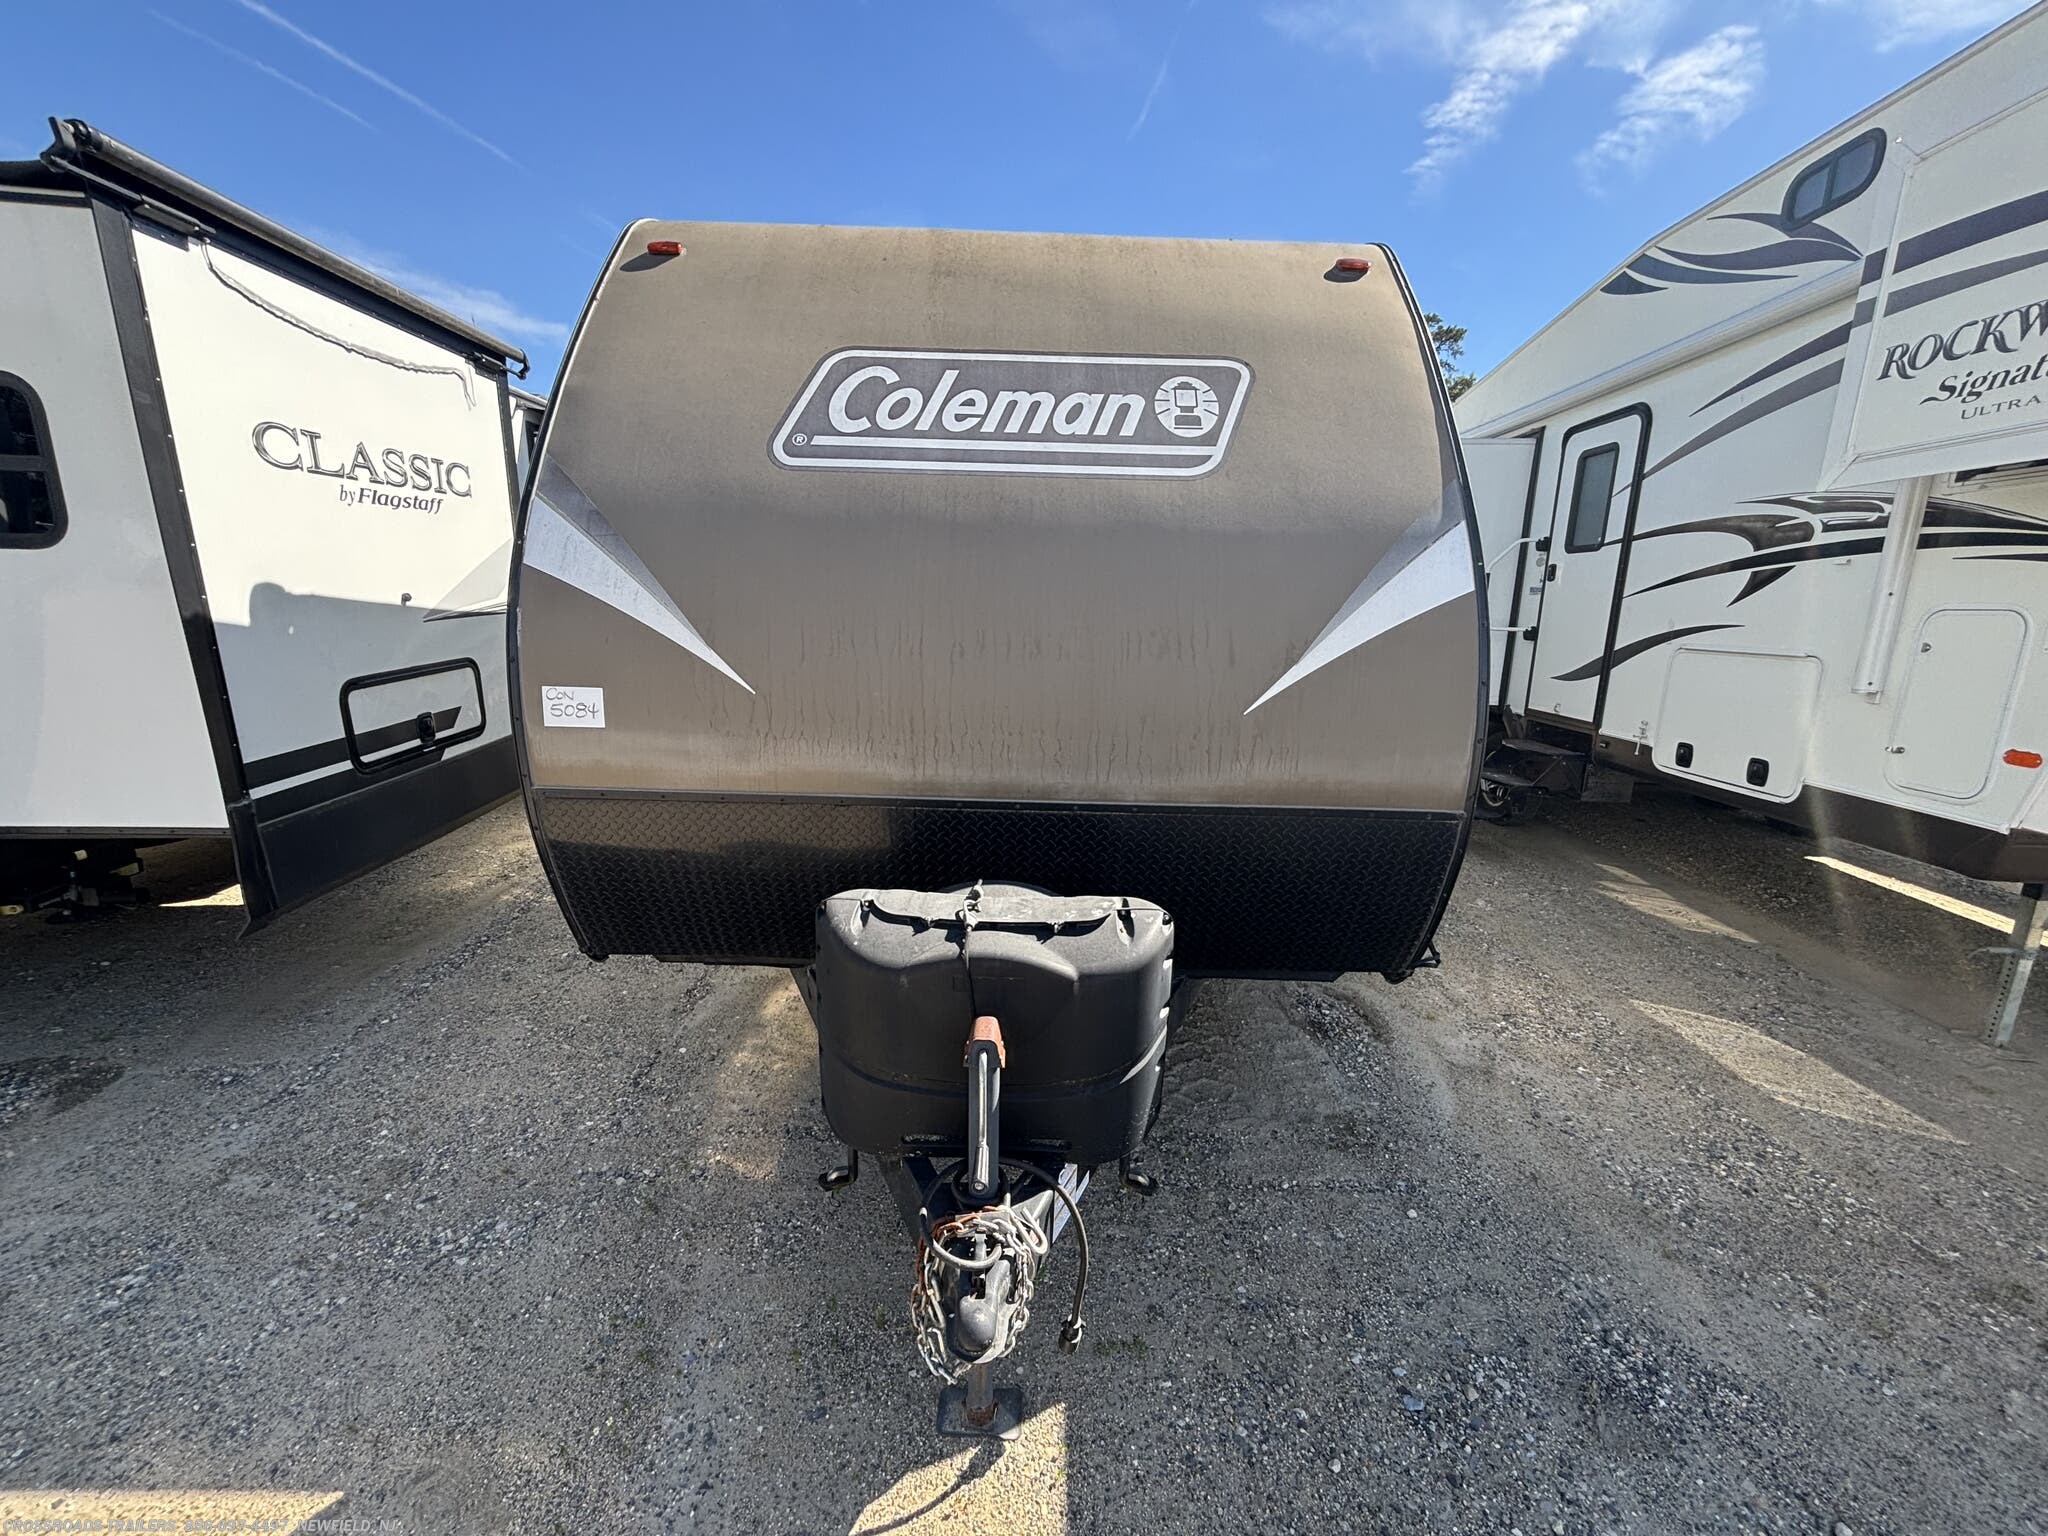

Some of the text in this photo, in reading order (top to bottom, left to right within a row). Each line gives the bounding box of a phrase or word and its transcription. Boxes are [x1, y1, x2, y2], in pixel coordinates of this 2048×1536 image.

[1919, 354, 2048, 405] Signat
[828, 365, 1145, 437] Coleman
[1961, 395, 2041, 419] ULTRA
[252, 421, 472, 498] CLASSIC
[339, 485, 444, 514] by Flagstaff
[551, 702, 599, 719] 5084
